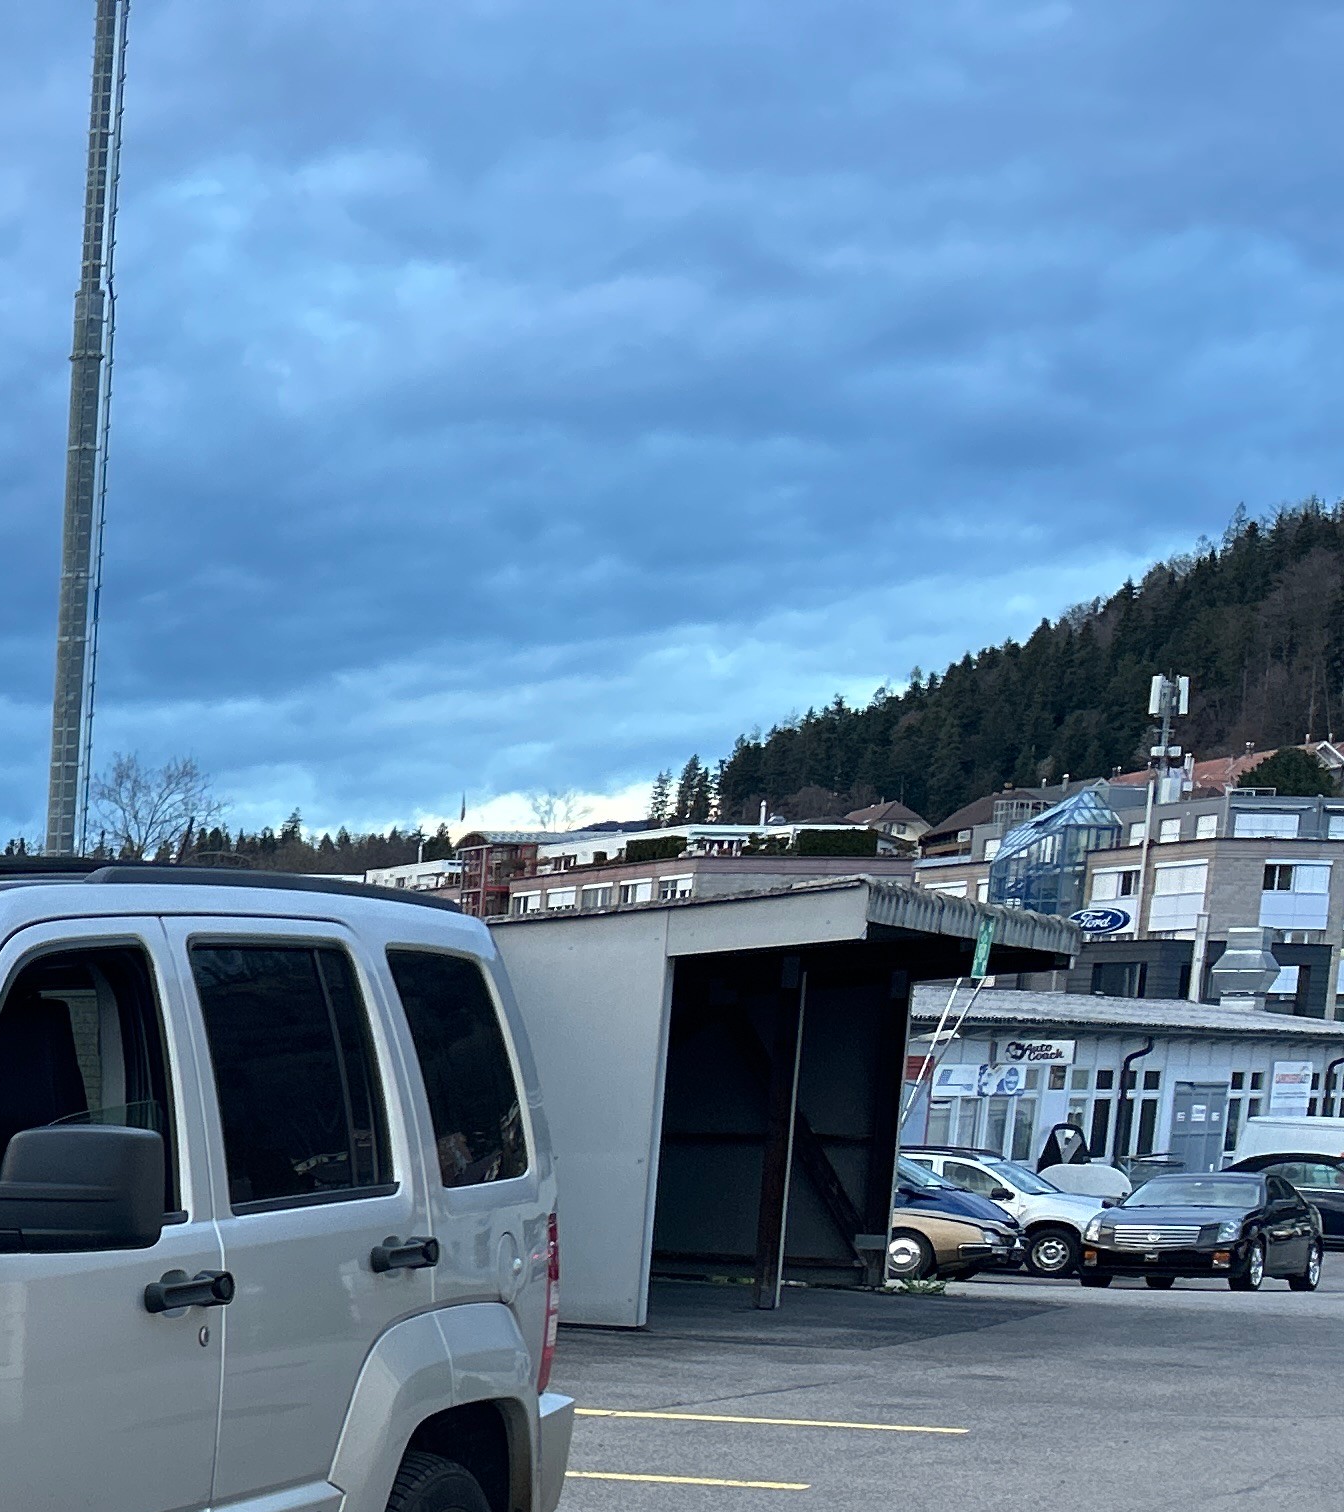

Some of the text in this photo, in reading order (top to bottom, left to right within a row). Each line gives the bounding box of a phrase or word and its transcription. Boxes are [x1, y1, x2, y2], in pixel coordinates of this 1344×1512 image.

[1079, 911, 1112, 928] Ford
[1025, 1042, 1053, 1053] Auto
[1028, 1049, 1064, 1061] Coach
